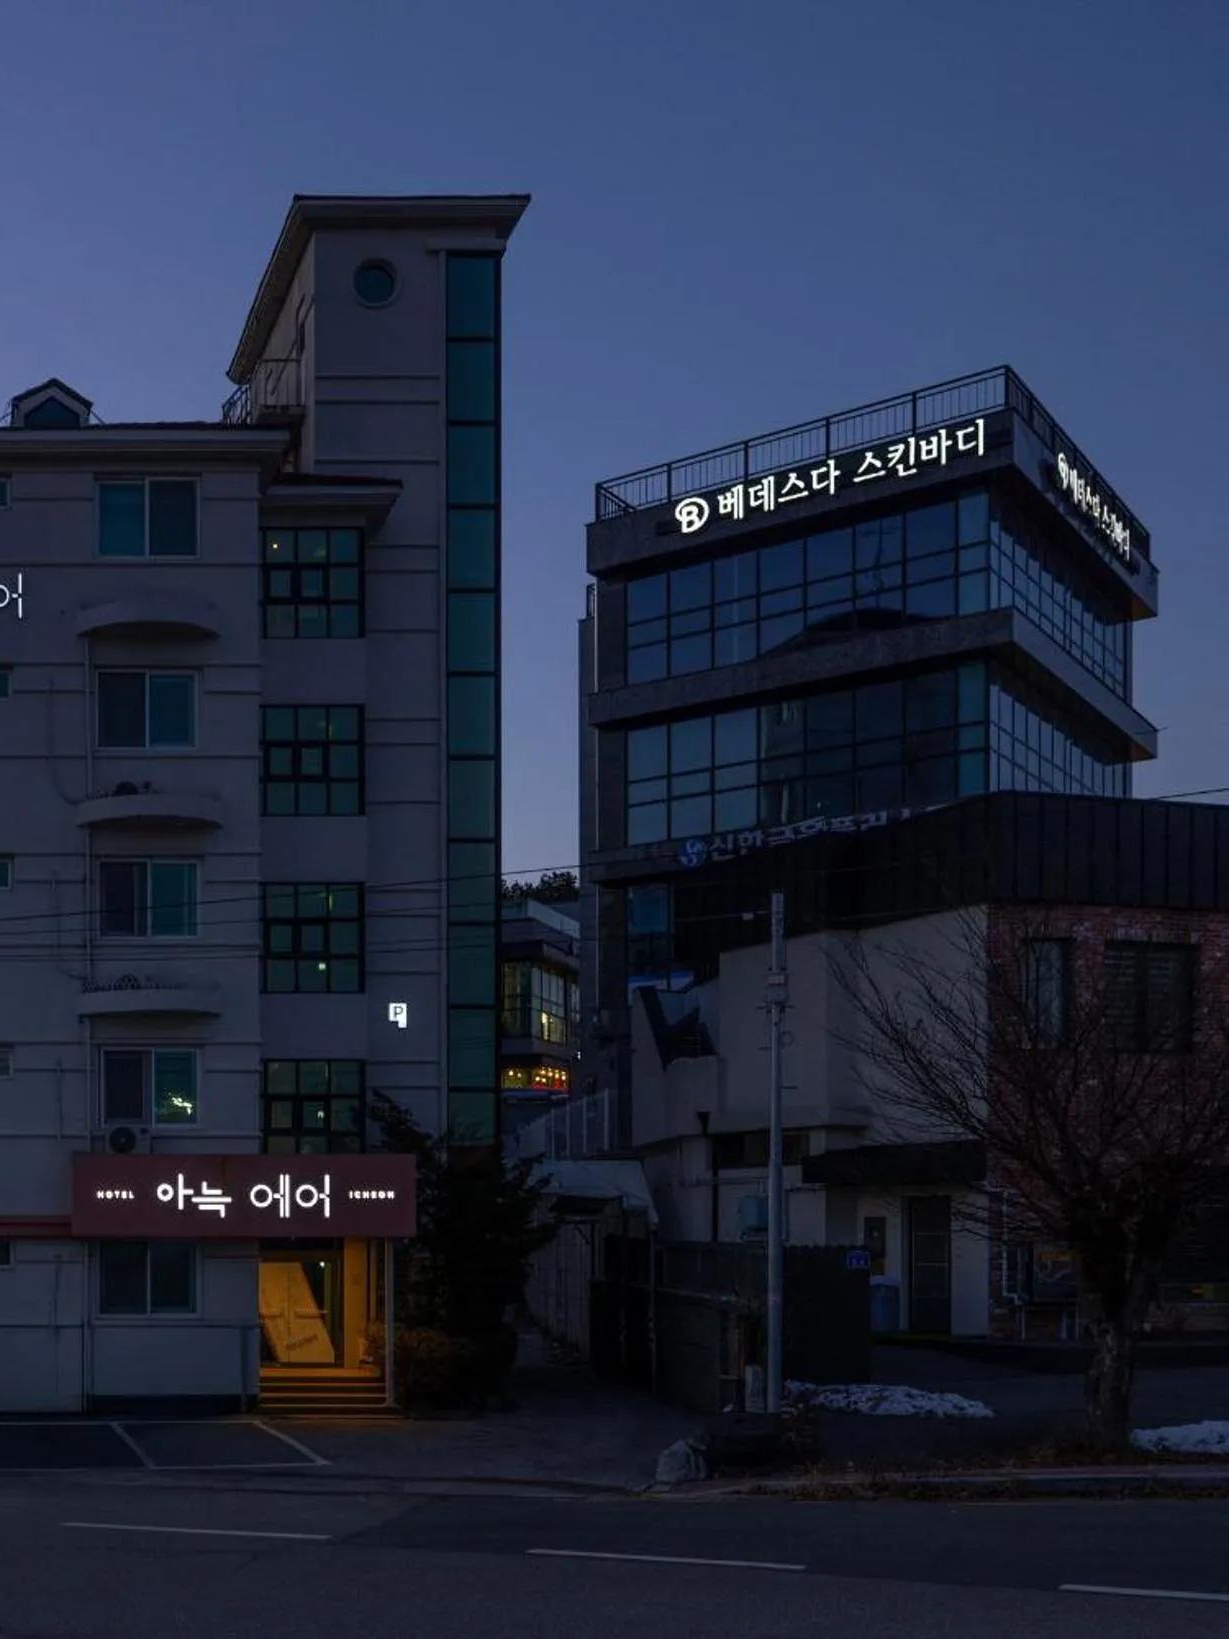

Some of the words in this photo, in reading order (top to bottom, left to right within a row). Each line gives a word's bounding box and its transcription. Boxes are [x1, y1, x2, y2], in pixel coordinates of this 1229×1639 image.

[717, 459, 841, 520] 베데스다
[853, 418, 985, 483] 스킨바디
[96, 1189, 135, 1200] HOTEL
[156, 1172, 233, 1219] 아늑
[249, 1173, 331, 1219] 에어
[348, 1190, 395, 1200] ICHEON
